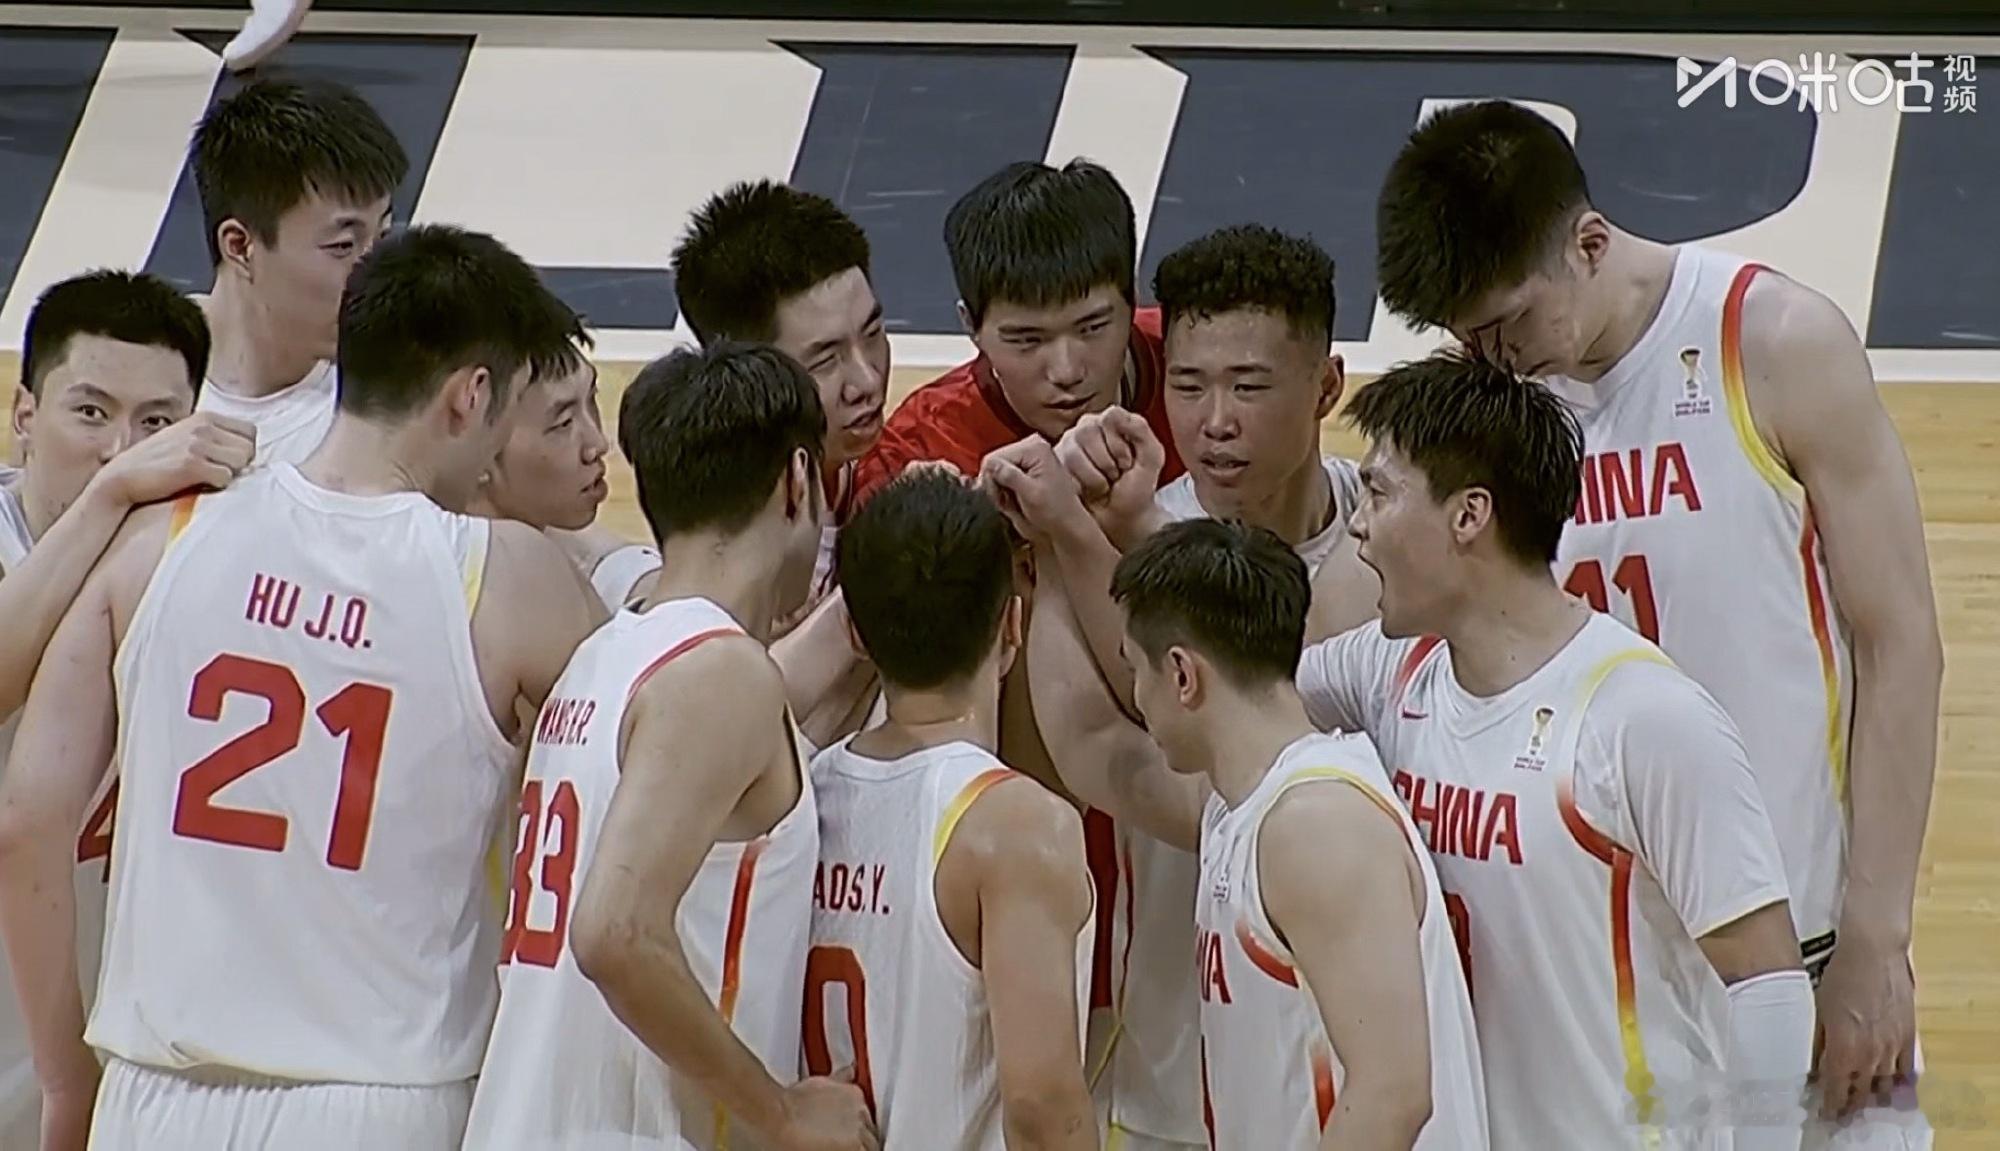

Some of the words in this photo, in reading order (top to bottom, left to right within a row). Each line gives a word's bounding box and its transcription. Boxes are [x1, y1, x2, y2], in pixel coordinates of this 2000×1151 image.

[246, 572, 301, 629] HU
[303, 593, 372, 649] J.Q.
[172, 652, 393, 871] 21
